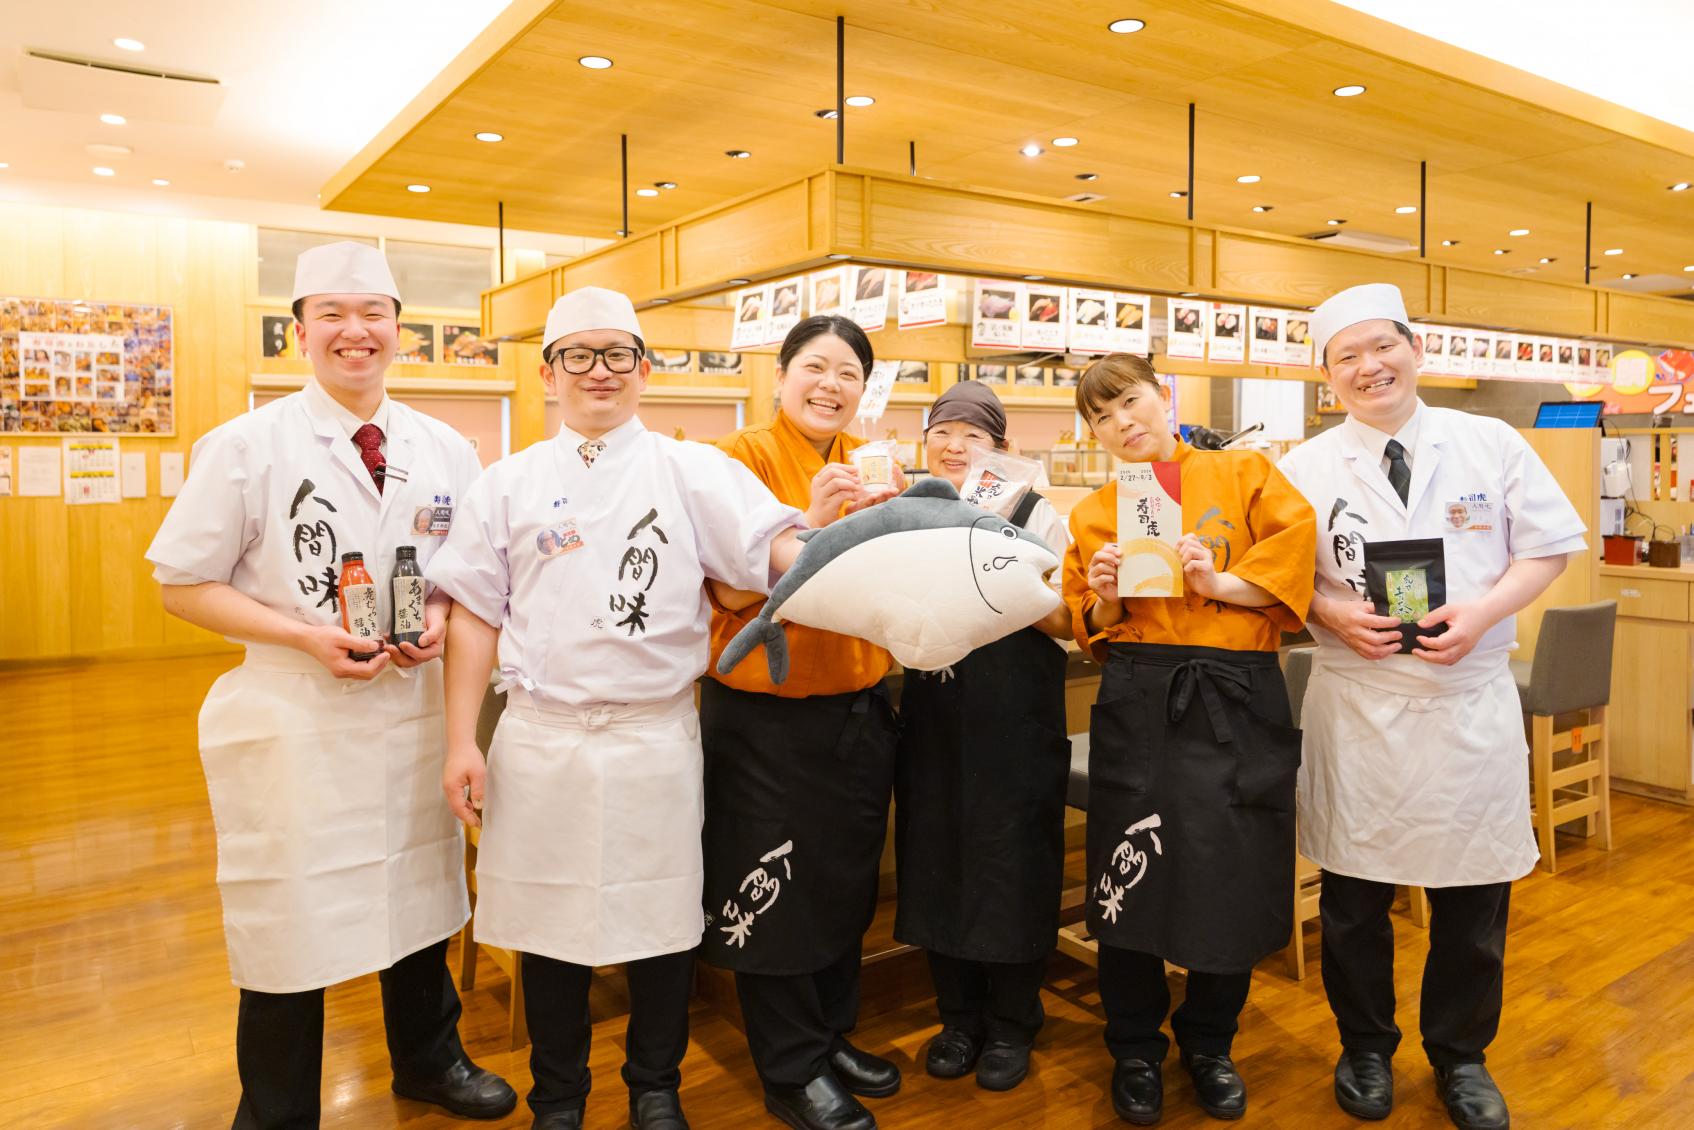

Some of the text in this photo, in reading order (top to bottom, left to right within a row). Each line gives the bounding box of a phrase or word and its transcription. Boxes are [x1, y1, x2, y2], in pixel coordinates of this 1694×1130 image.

[1136, 497, 1160, 537] 寿司虎
[409, 578, 422, 621] あまくち
[609, 508, 669, 637] 人間味
[719, 839, 793, 949] 人間味
[1098, 813, 1163, 925] 人間味
